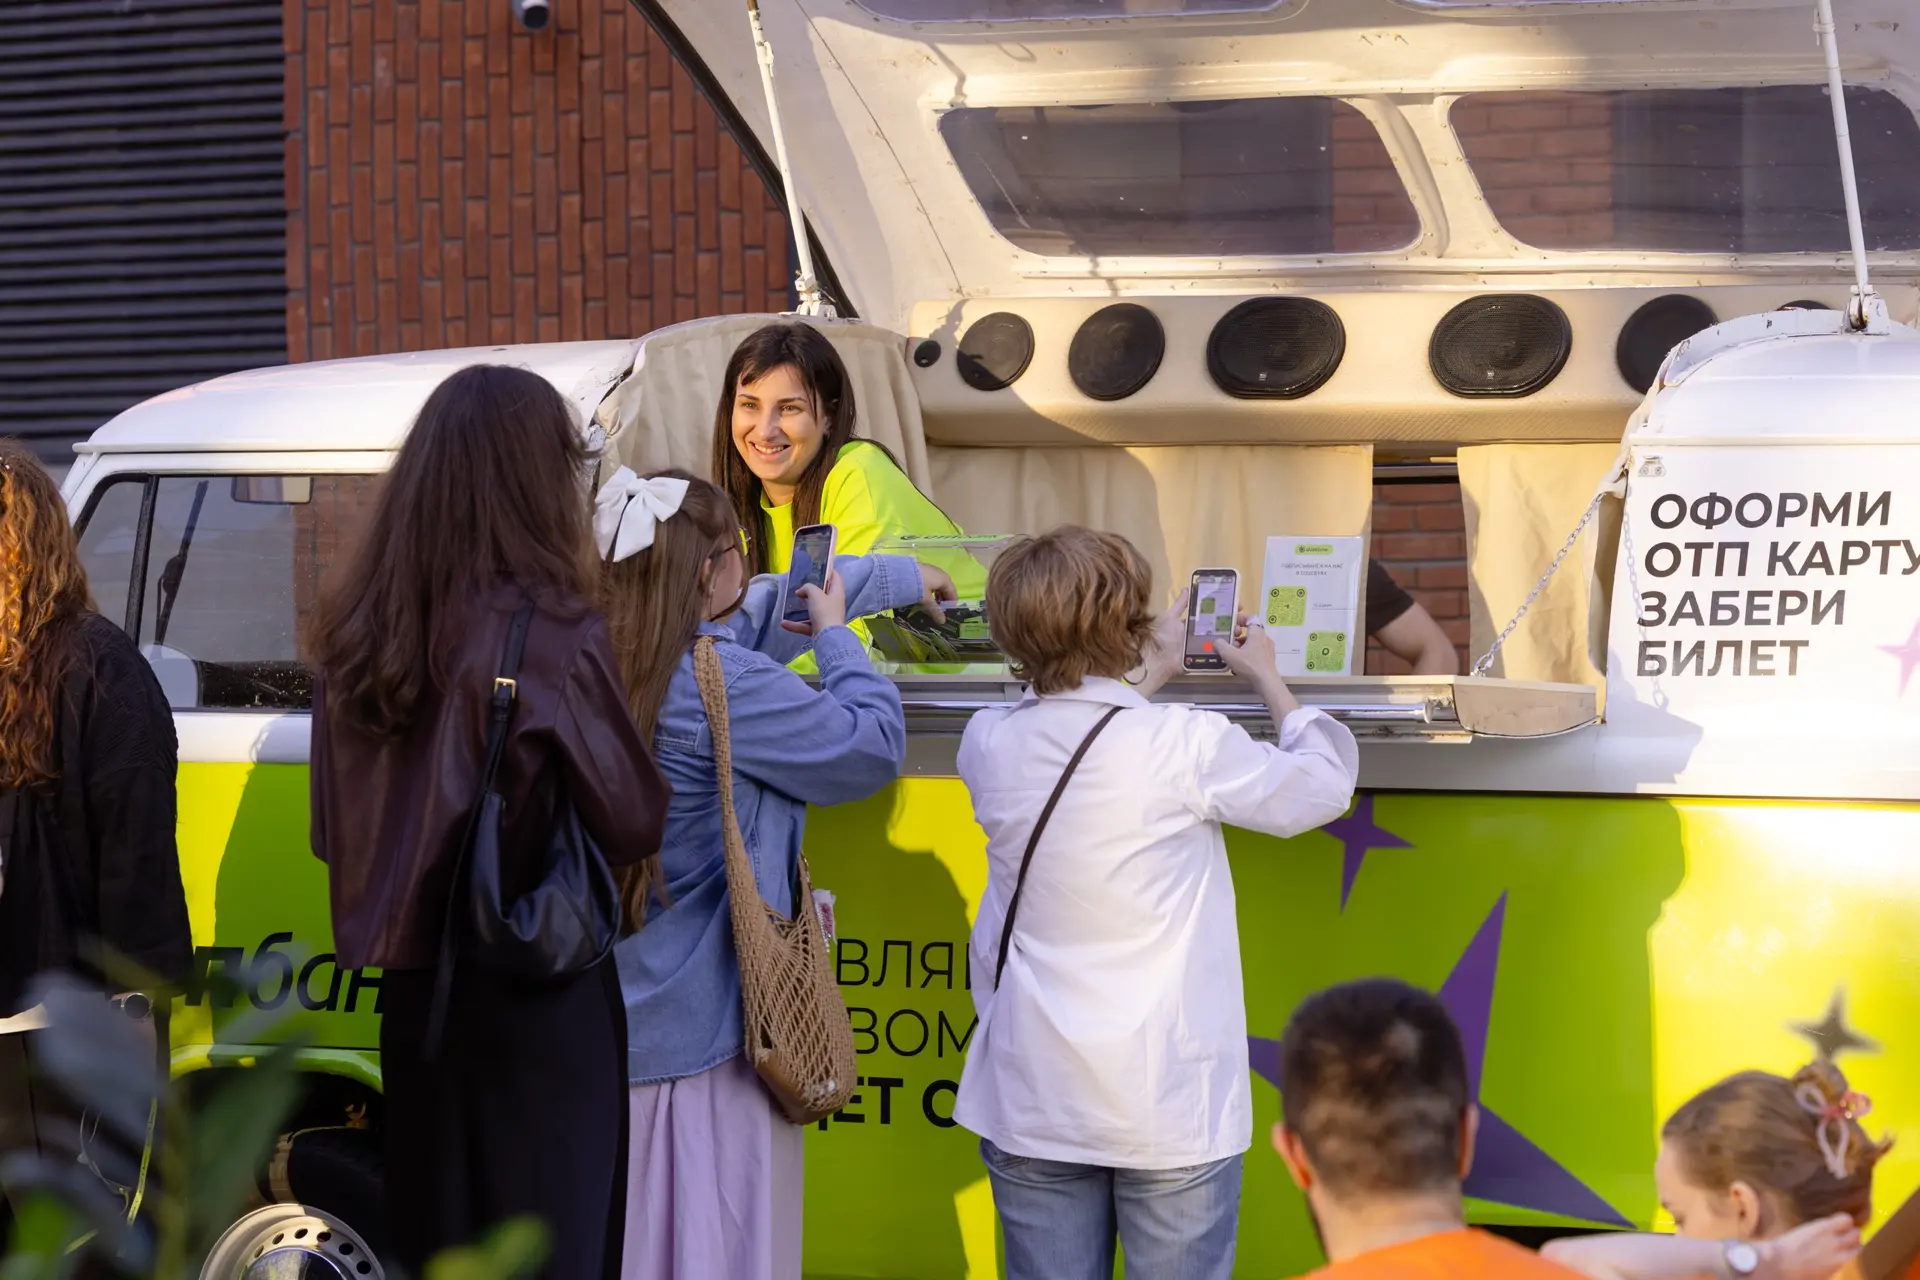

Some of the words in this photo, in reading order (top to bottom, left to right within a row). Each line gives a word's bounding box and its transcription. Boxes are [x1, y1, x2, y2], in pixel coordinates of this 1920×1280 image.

[1650, 490, 1892, 530] ОФОРМИ
[1644, 541, 1750, 578] ОТП
[1636, 589, 1846, 628] ЗАБЕРИ
[1636, 639, 1810, 677] БИЛЕТ
[836, 938, 971, 991] ВЛЯ
[818, 1076, 904, 1131] ЕТ
